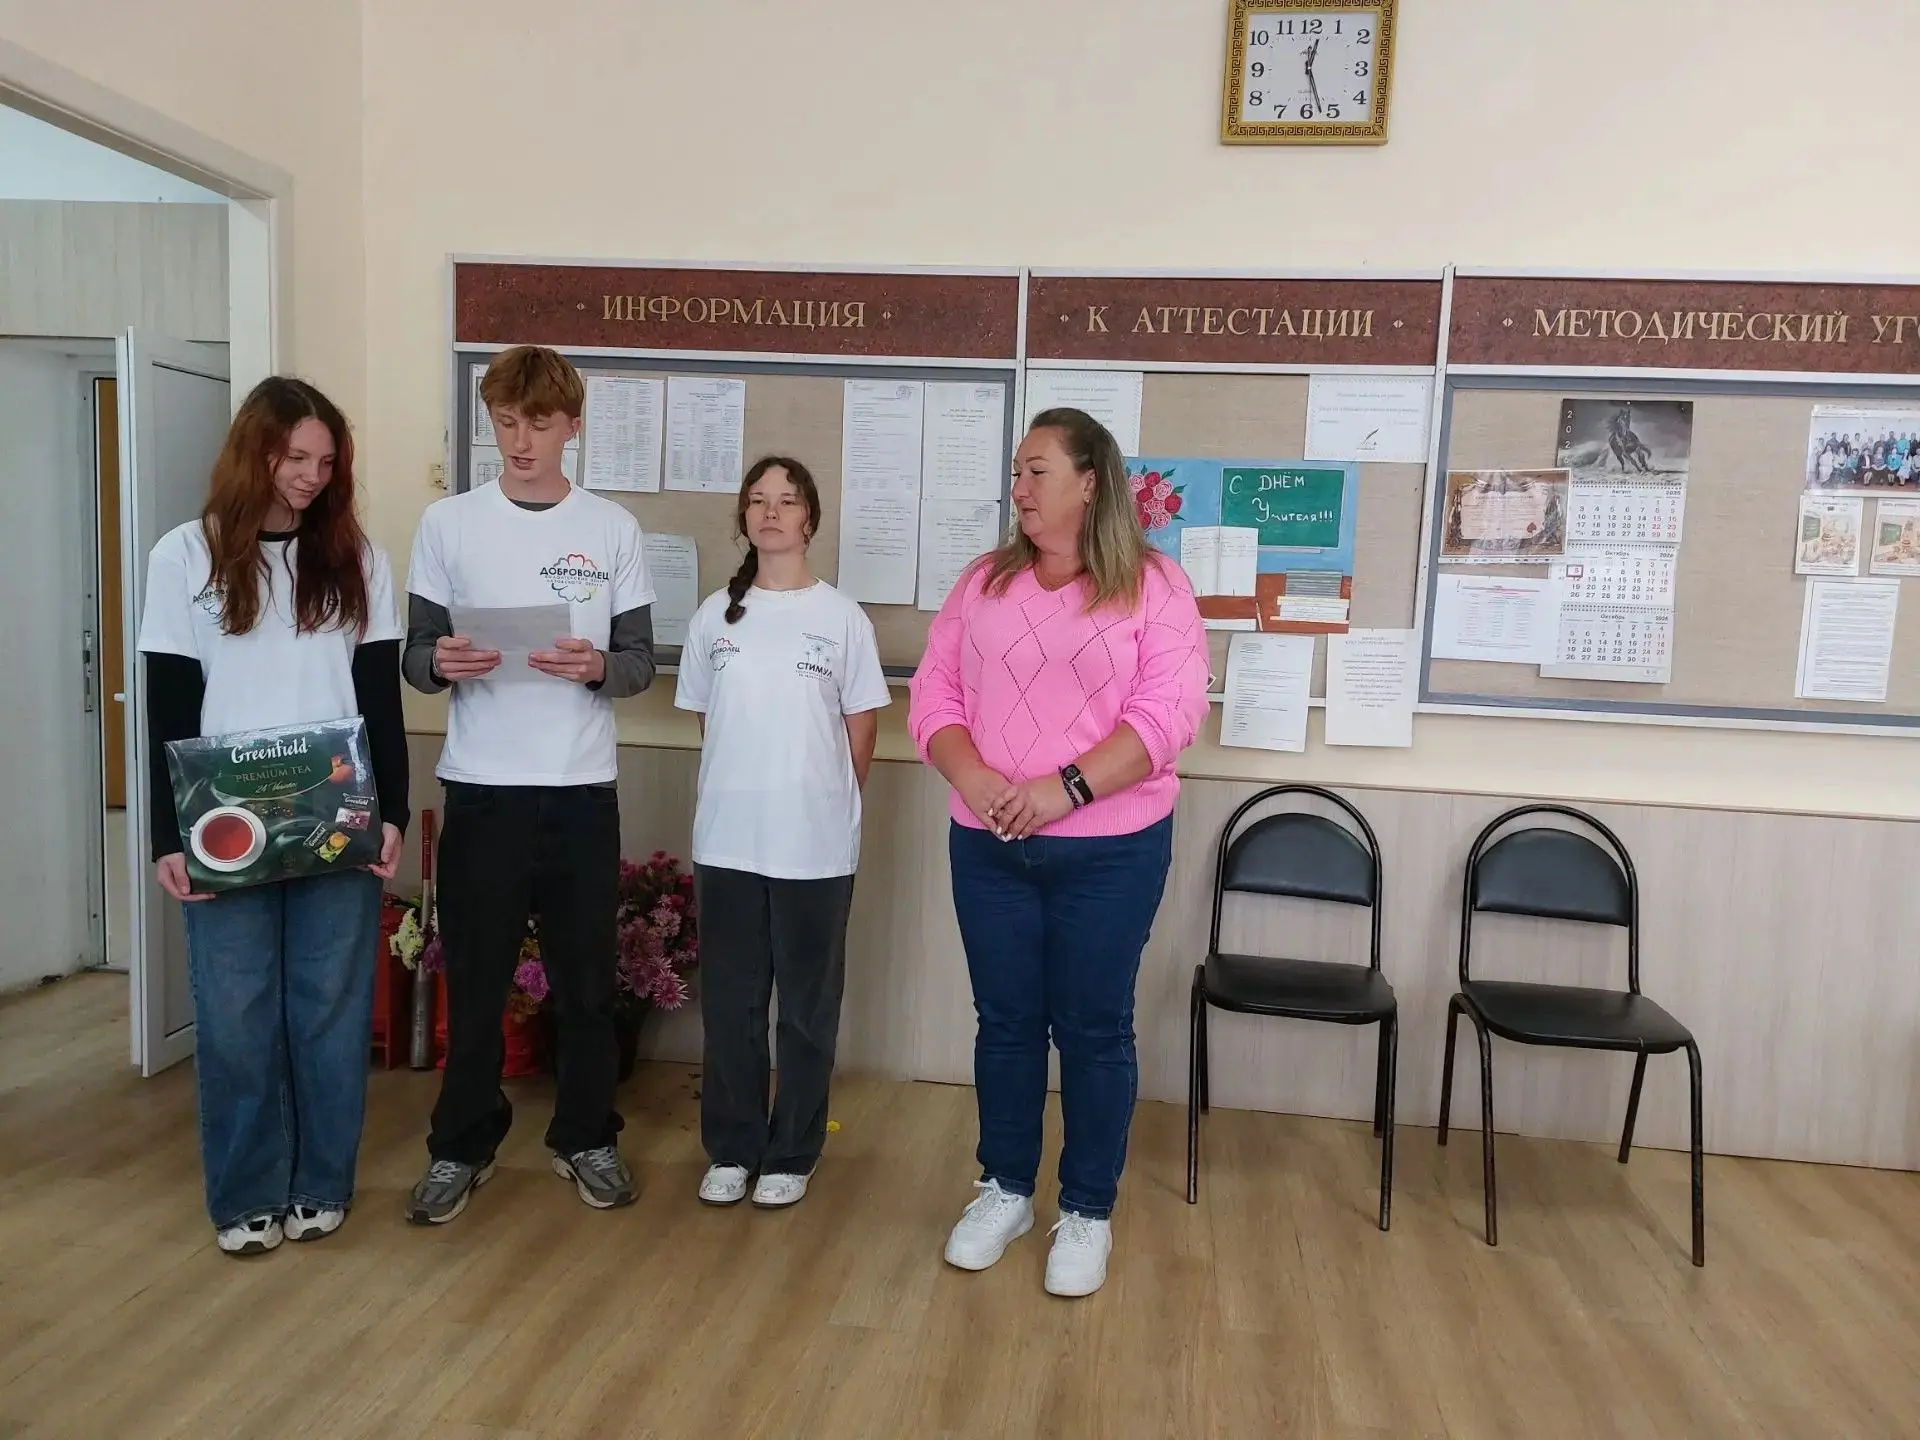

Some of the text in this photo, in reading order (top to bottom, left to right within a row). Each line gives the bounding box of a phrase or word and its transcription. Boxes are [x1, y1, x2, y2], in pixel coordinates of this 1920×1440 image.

[1277, 20, 1294, 35] 11
[1300, 19, 1323, 35] 12
[1334, 19, 1343, 35] 1
[1249, 31, 1269, 45] 10
[1356, 29, 1371, 45] 2
[1251, 62, 1264, 78] 9
[1354, 61, 1368, 77] 3
[1250, 91, 1263, 106] 8
[1353, 91, 1367, 105] 4
[1274, 105, 1288, 119] 7
[1300, 104, 1314, 119] 6
[1326, 104, 1340, 119] 5
[602, 295, 866, 332] ИНФОРМАЦИЯ
[1086, 305, 1375, 342] К АТТЕСТАЦИИ
[1532, 308, 1920, 345] МЕТОДИЧЕСКИЙ УГ
[1229, 472, 1305, 495] С ДНЁМ
[540, 567, 609, 581] ДОБРОВОЛЕЦ
[797, 661, 832, 677] СТИМУЛ
[231, 737, 309, 764] Greenfield
[235, 769, 288, 782] PREMIUM
[290, 765, 312, 775] TEA
